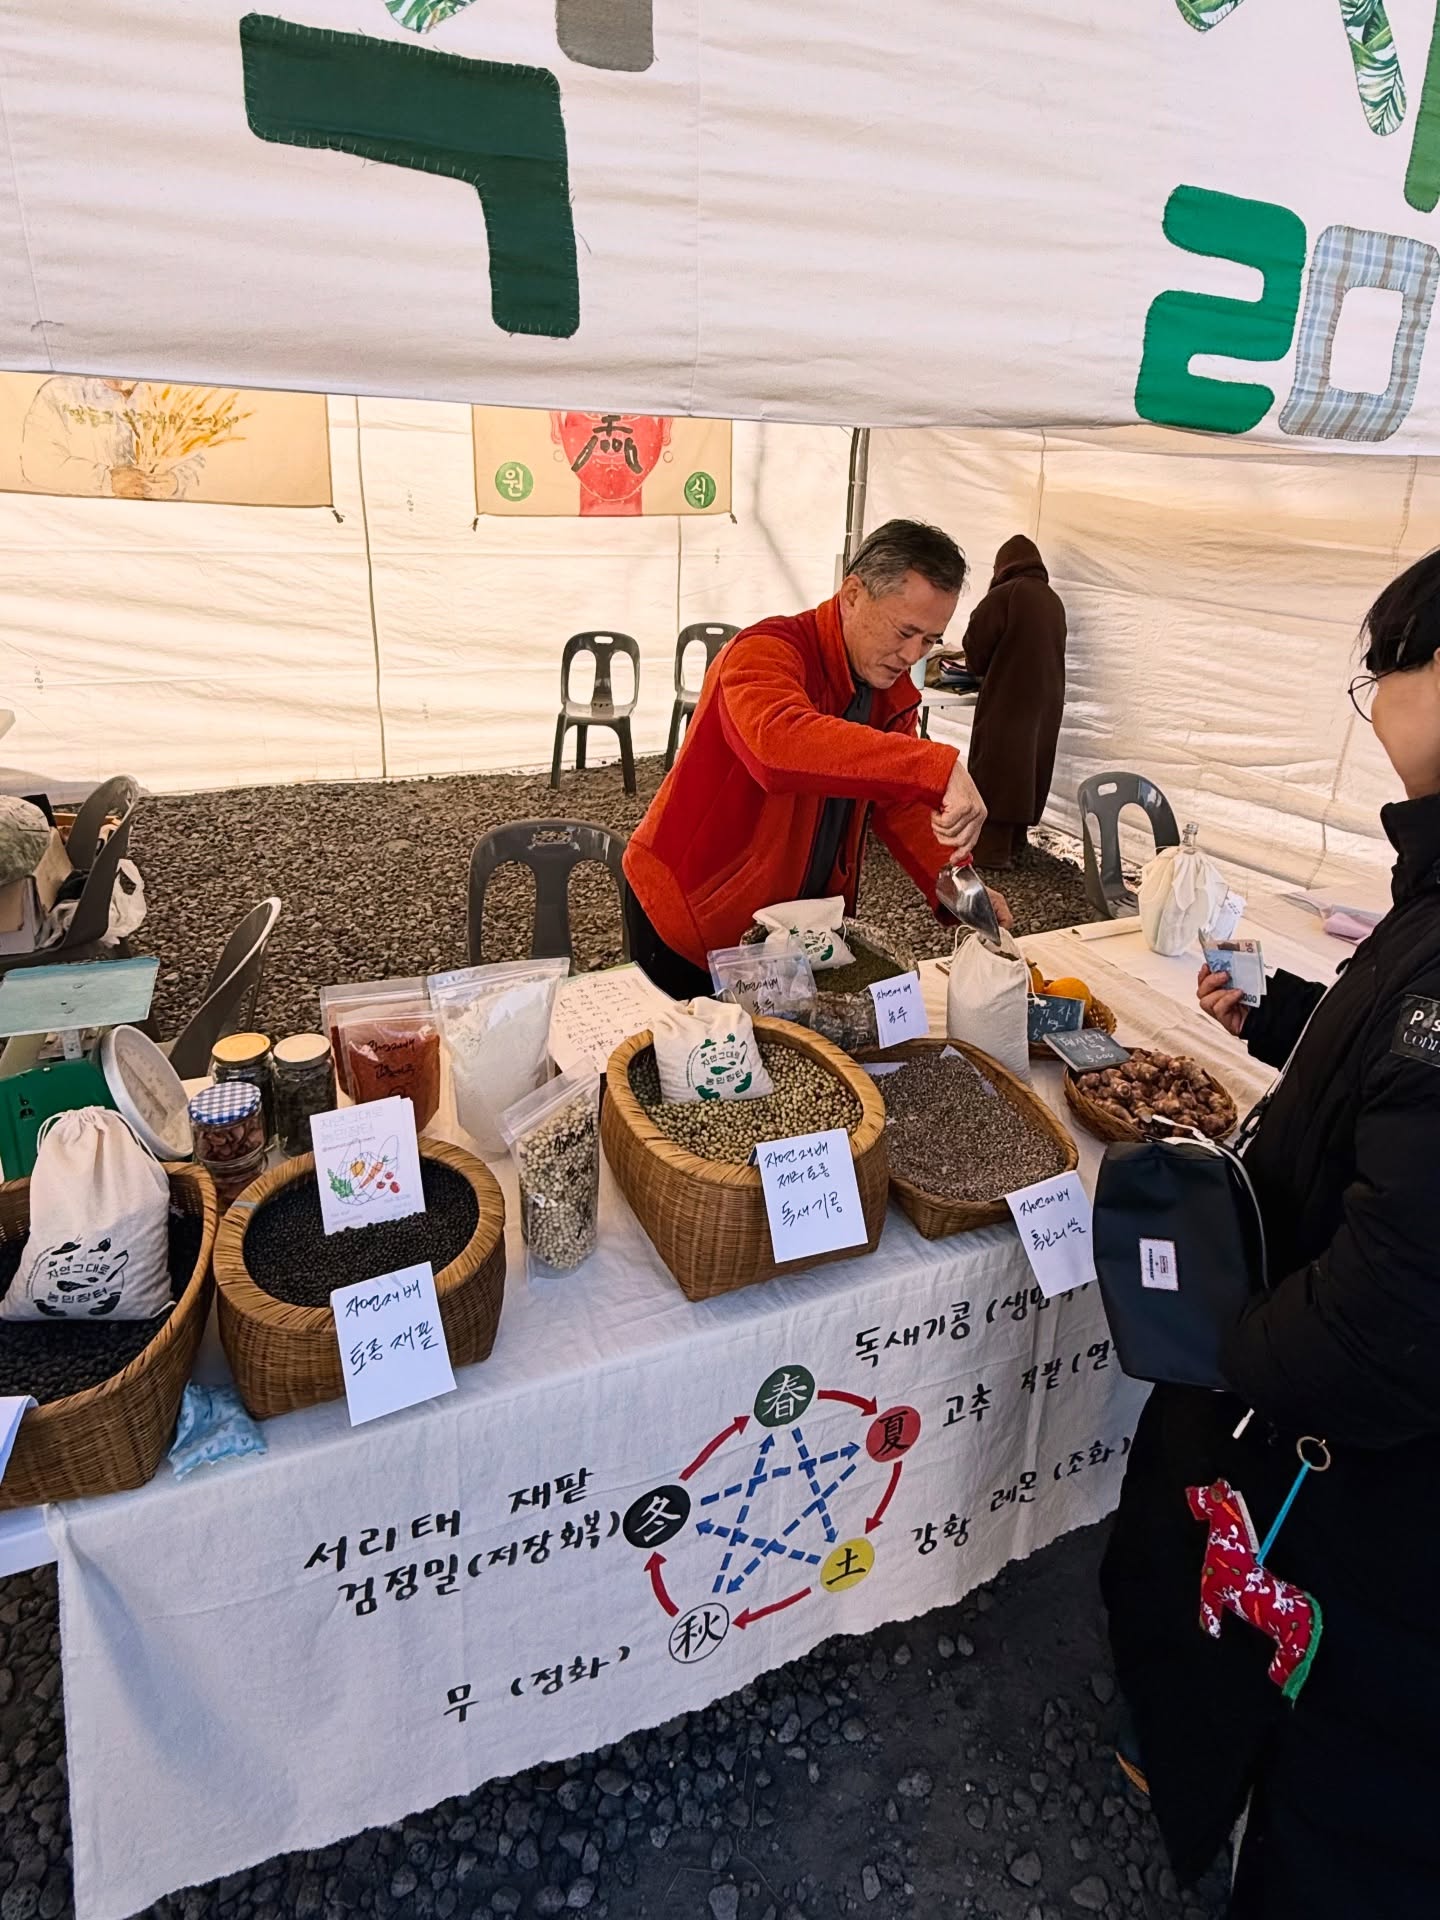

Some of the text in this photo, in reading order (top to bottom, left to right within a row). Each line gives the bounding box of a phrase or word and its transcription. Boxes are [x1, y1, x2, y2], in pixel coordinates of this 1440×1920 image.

[887, 1006, 908, 1024] 녹두
[701, 1050, 740, 1069] 자연그대로
[705, 1068, 745, 1086] 농민장터
[764, 1141, 829, 1169] 자연재배
[781, 1191, 843, 1228] 독새기콩
[46, 1263, 111, 1280] 자연그대로
[47, 1287, 108, 1304] 농민장터
[345, 1279, 422, 1318] 자연재배
[855, 1300, 971, 1368] 독새기콩
[350, 1337, 383, 1376] 토종
[763, 1373, 807, 1420] 春
[942, 1383, 993, 1428] 고추
[1020, 1357, 1063, 1395] 적팥
[877, 1409, 911, 1457] 夏
[911, 1436, 1131, 1555] 강황 레몬 (조화)
[304, 1467, 594, 1572] 서리태 재팥
[634, 1496, 681, 1543] 冬
[826, 1547, 867, 1586] 土
[672, 1611, 722, 1659] 秋
[443, 1645, 631, 1723] 무 (정화)
